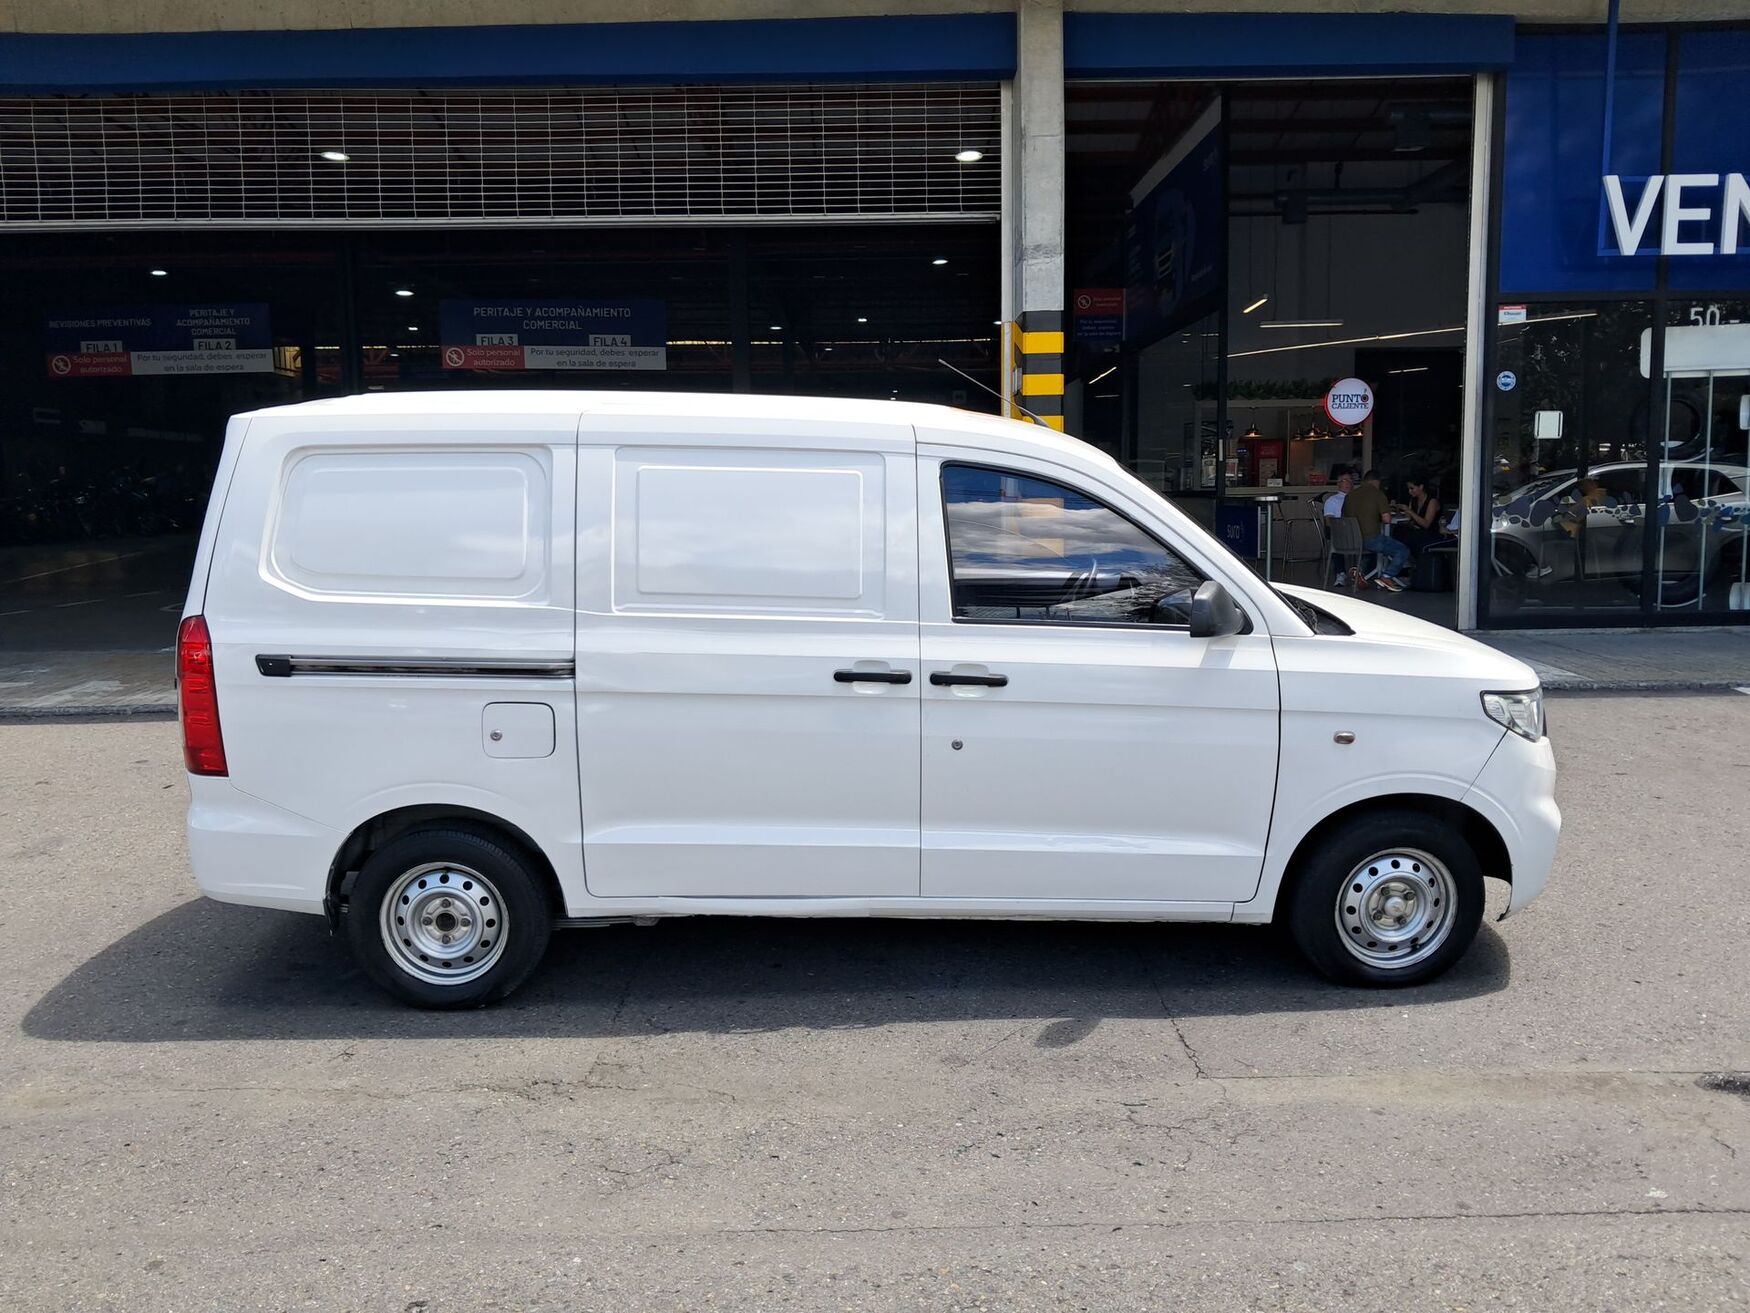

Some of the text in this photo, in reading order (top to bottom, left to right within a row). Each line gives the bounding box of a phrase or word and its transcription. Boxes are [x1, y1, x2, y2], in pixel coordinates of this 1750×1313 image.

[1602, 173, 1750, 256] VEN
[473, 305, 631, 318] PERITAJE Y ACOMPAÑAMIENTO
[97, 318, 152, 327] PREVENTIVAS
[176, 317, 250, 327] ACOMPAÑAMIENTO
[523, 320, 583, 330] COMERCIAL
[191, 328, 236, 336] COMERCIAL
[198, 340, 232, 350] FILA 2
[480, 336, 514, 345] FILA 3
[593, 337, 627, 347] FILA 4
[86, 343, 110, 352] FILA
[137, 354, 151, 362] Por
[466, 348, 520, 358] Solo personal
[530, 348, 544, 356] Por
[545, 348, 554, 356] tu
[600, 348, 625, 356] debes
[628, 349, 659, 358] esperar
[216, 364, 244, 372] espera
[569, 359, 577, 367] la
[579, 359, 593, 367] sala
[596, 359, 607, 367] de
[609, 360, 637, 369] espera
